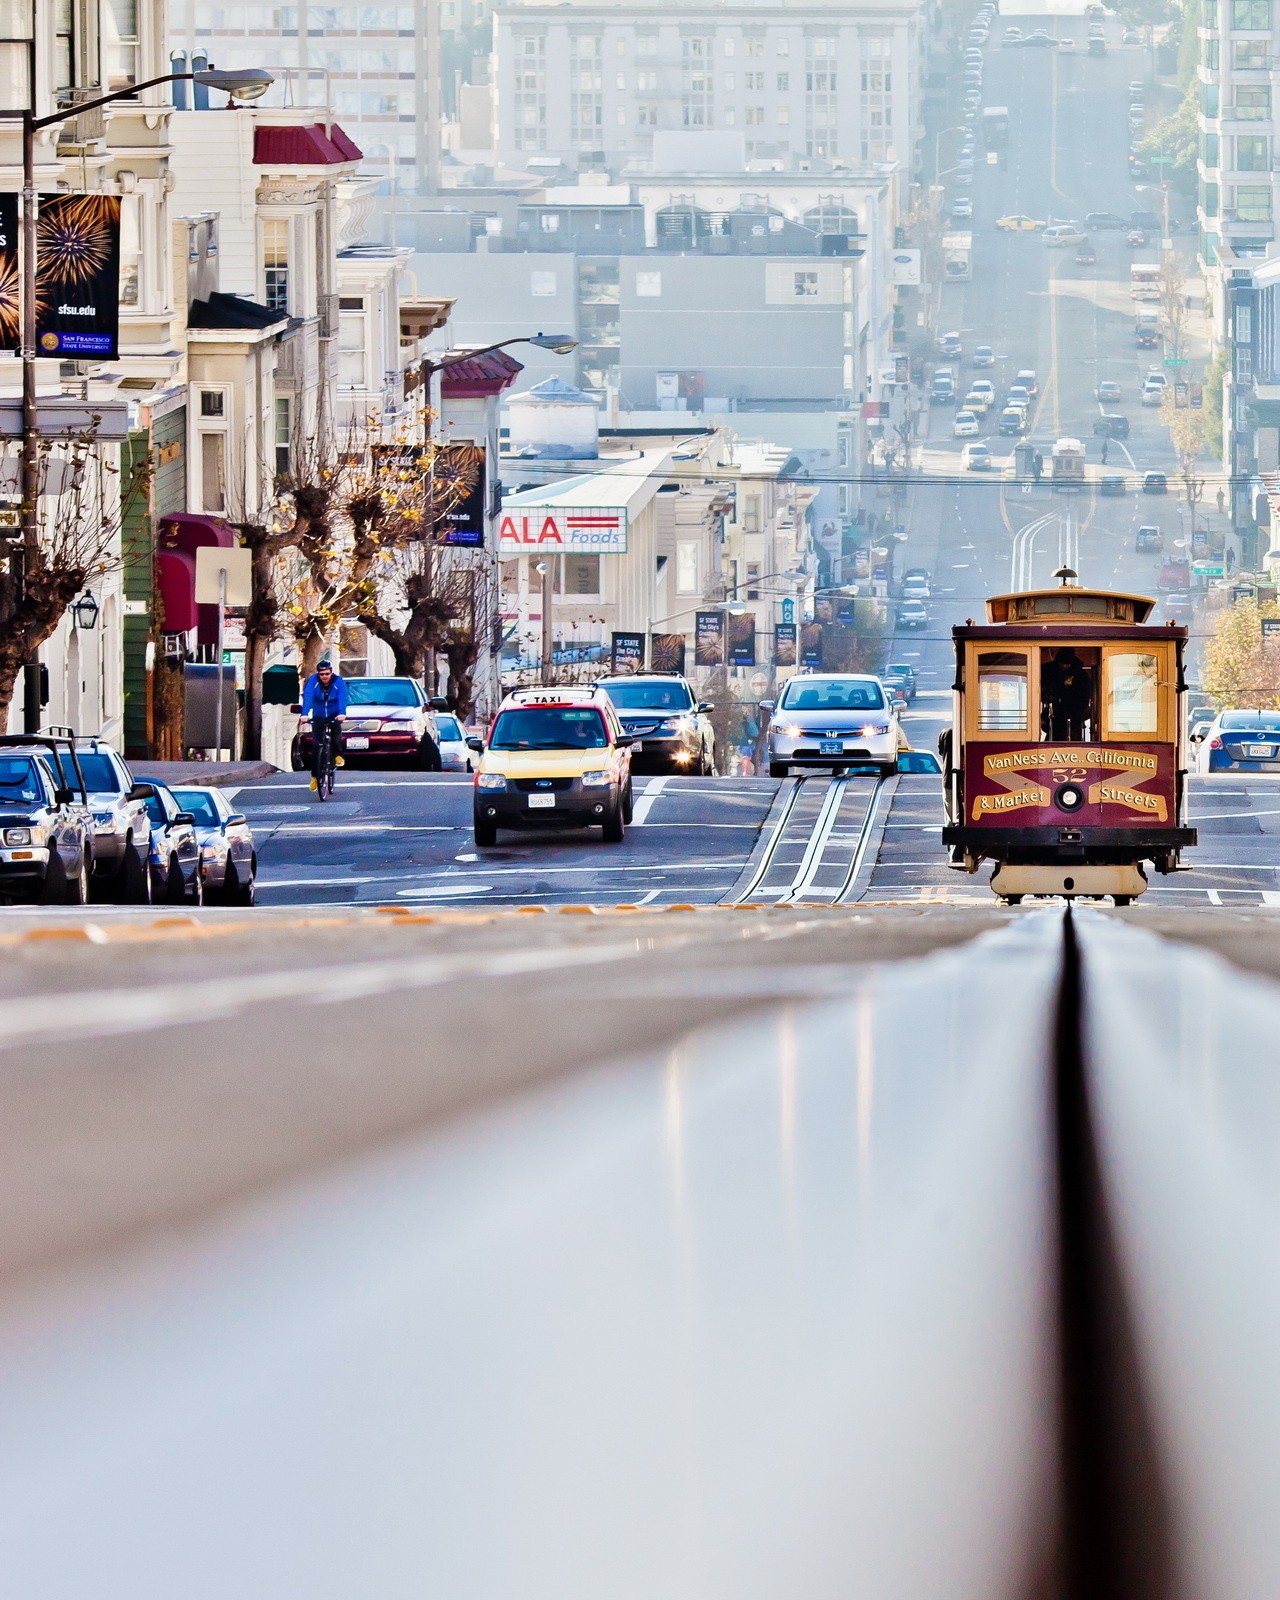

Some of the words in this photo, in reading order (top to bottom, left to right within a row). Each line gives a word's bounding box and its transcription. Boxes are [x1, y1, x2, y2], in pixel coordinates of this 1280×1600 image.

[58, 304, 96, 316] sfsu.edu
[570, 529, 620, 543] Foods
[987, 758, 1011, 769] Van
[1012, 753, 1046, 766] Ness
[1086, 751, 1155, 768] California
[1052, 768, 1087, 783] 52
[980, 797, 990, 809] &
[993, 790, 1044, 809] Market
[1100, 787, 1157, 808] Streets
